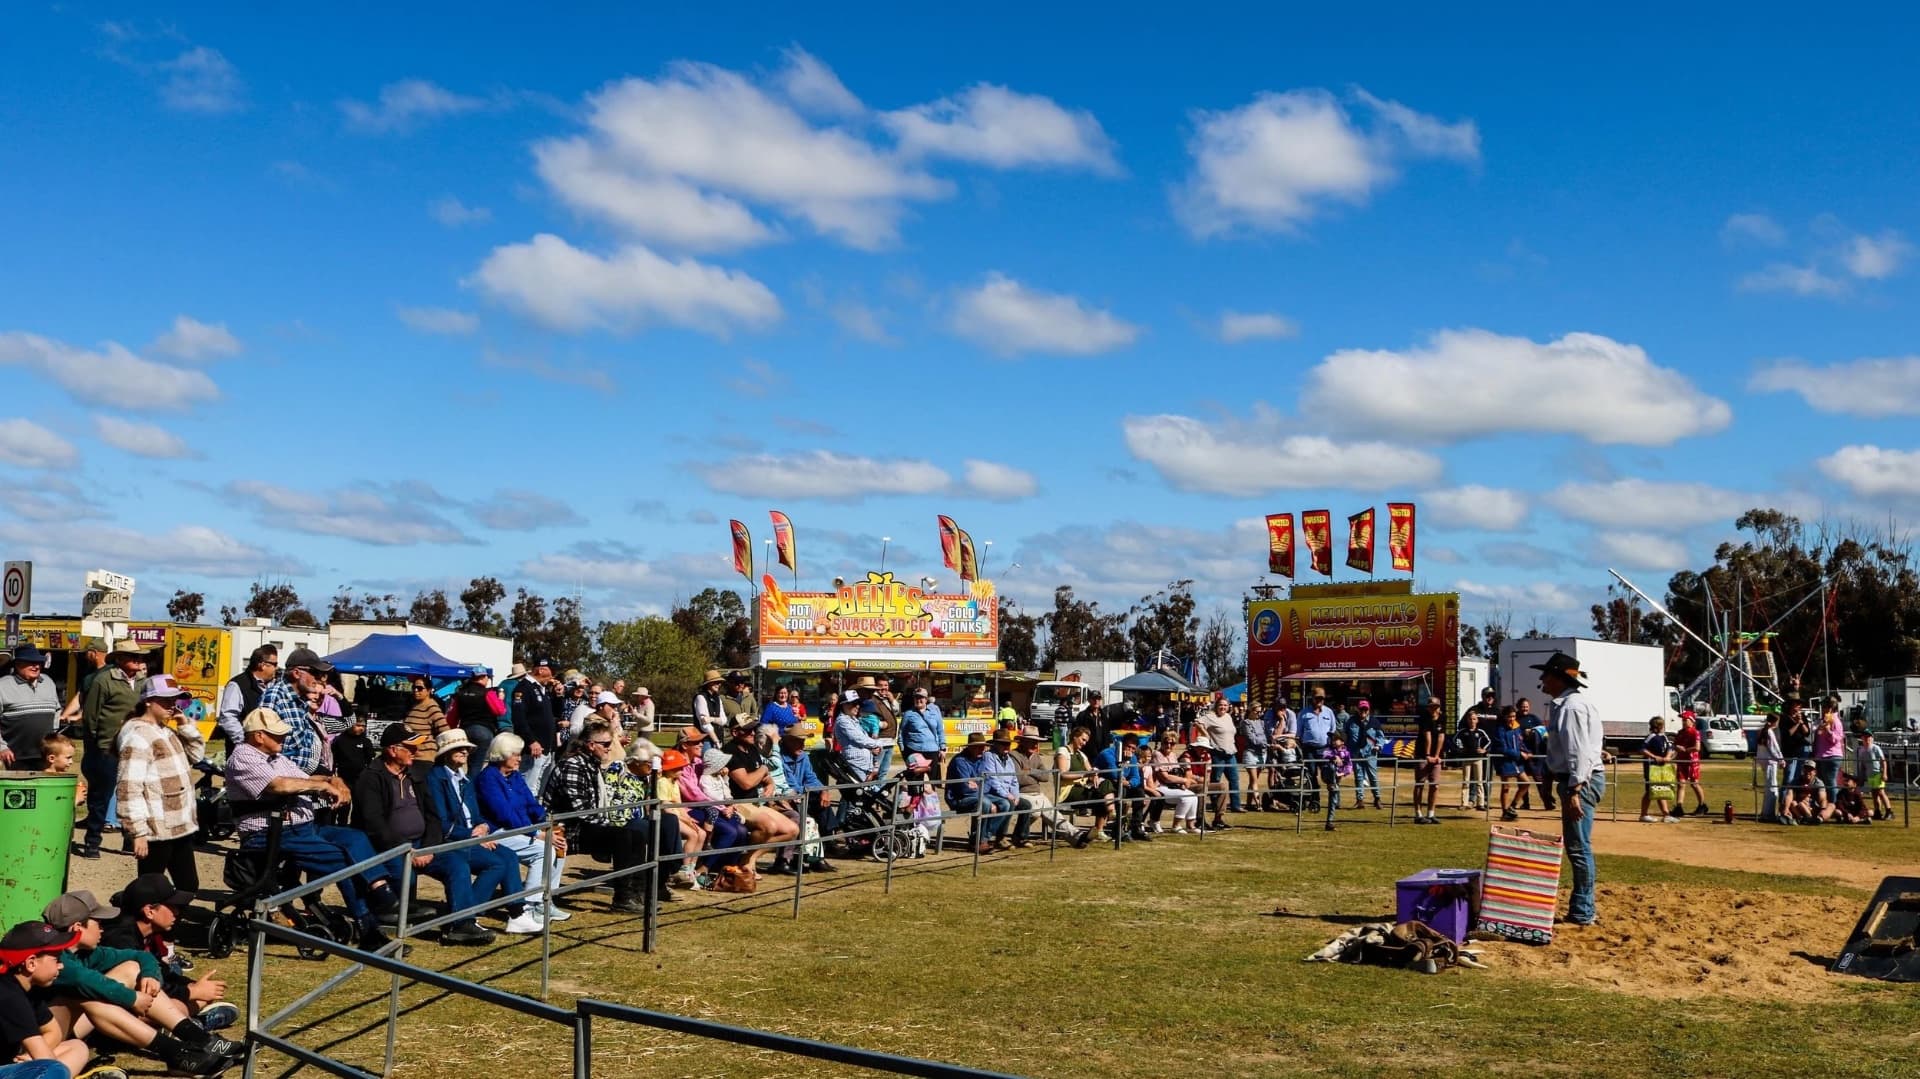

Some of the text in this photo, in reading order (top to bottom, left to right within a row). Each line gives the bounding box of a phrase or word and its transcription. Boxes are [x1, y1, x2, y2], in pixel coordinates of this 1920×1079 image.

[8, 578, 19, 597] 10
[105, 573, 129, 590] CATTLE
[87, 590, 123, 605] POULTRY
[838, 583, 922, 616] BELL'S
[94, 607, 123, 618] SHEEP
[789, 604, 811, 616] HOT
[948, 607, 975, 619] COLD
[1309, 602, 1418, 627] KELLI KLAVA'S
[785, 618, 813, 631] FOOD
[833, 618, 927, 632] SNACKS TO GO
[941, 620, 983, 633] DRINKS
[137, 630, 159, 640] TIME
[1304, 625, 1423, 649] TWISTED CHIPS
[211, 1039, 232, 1054] N
